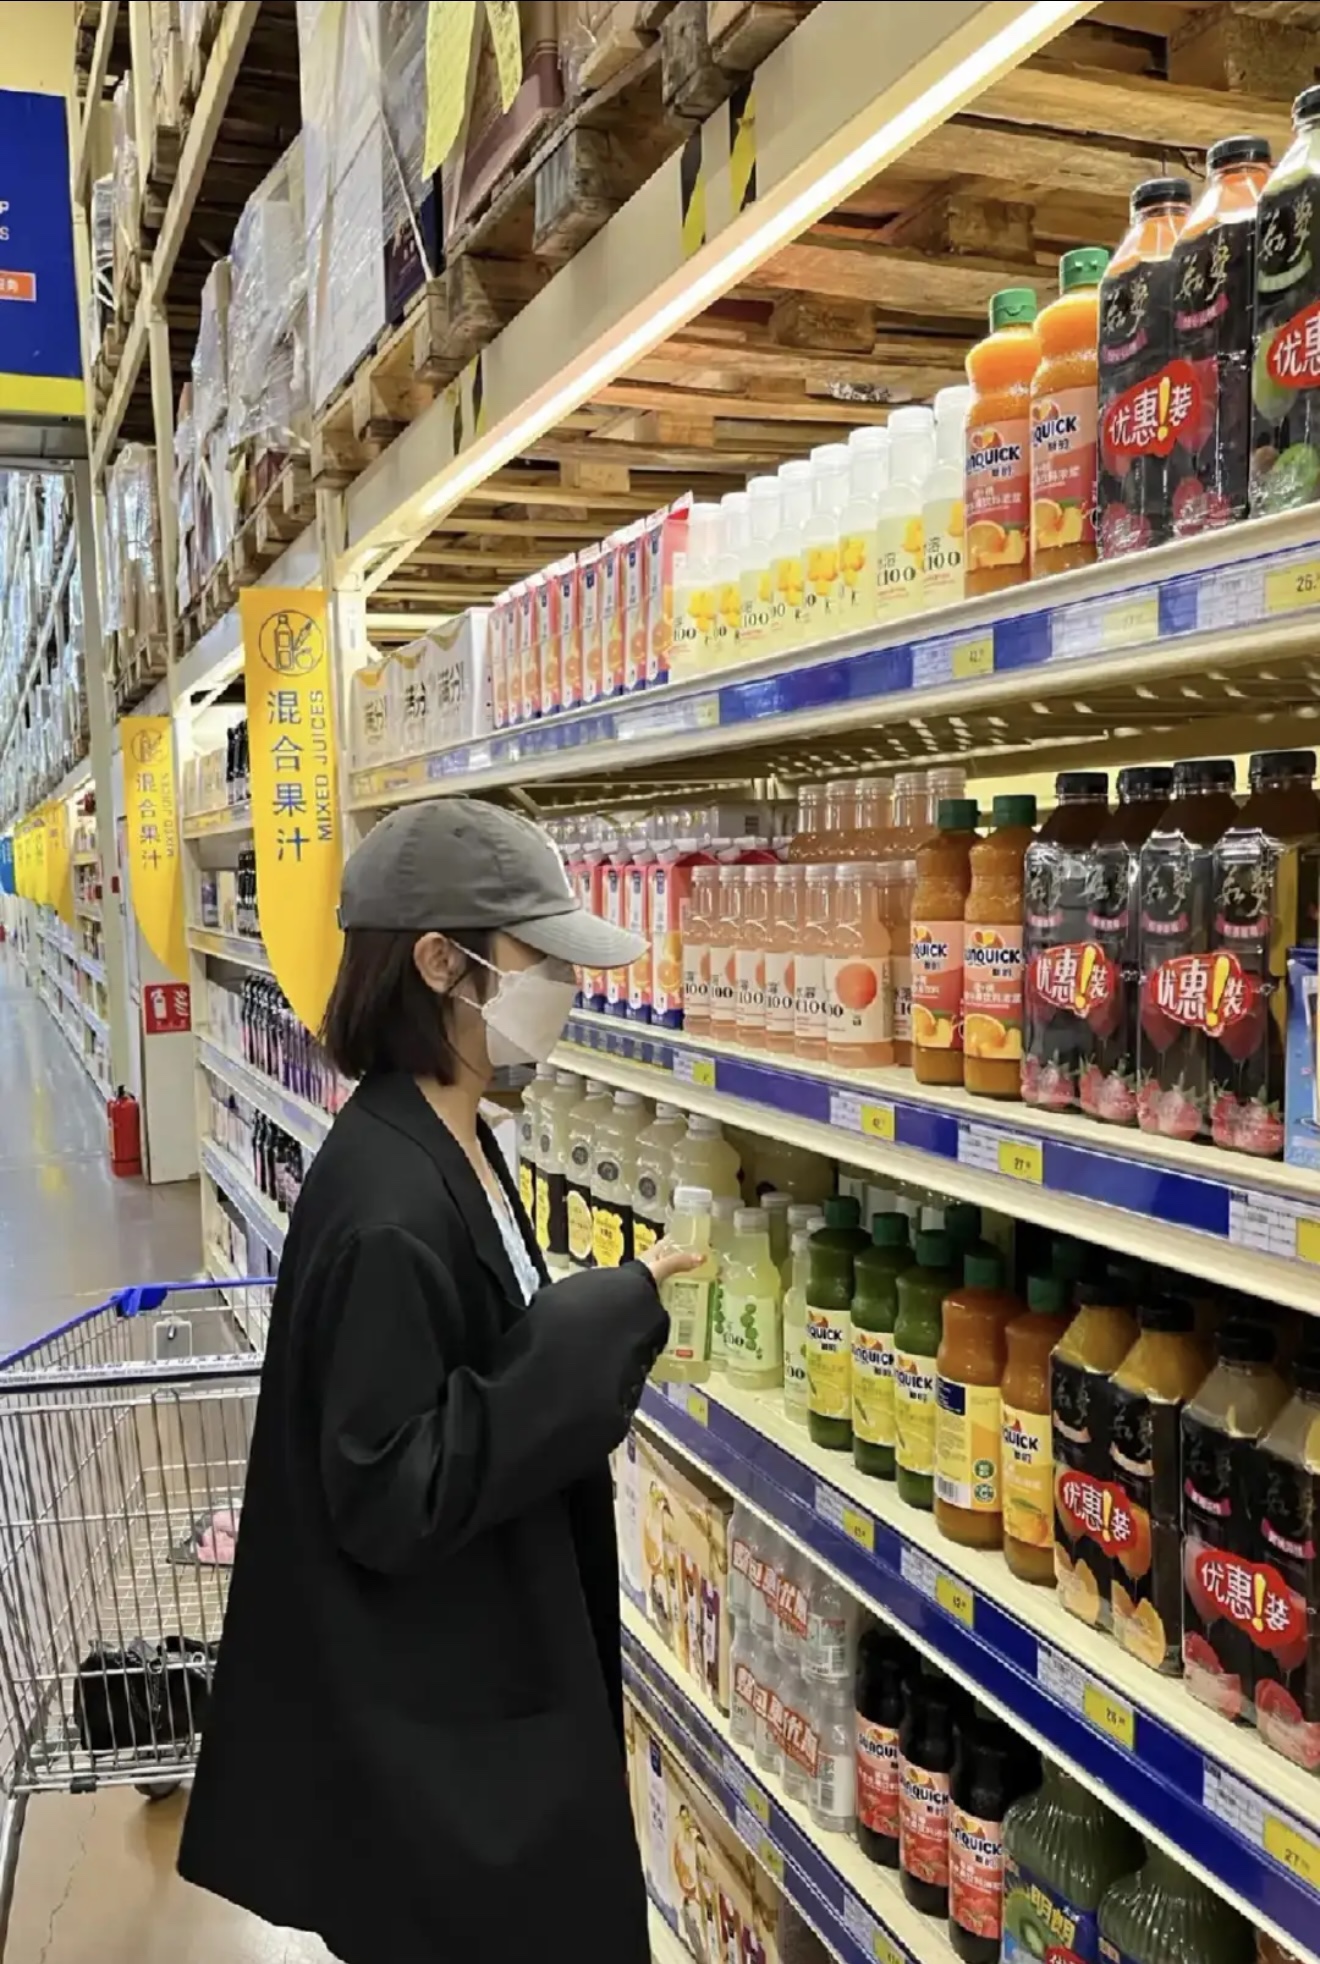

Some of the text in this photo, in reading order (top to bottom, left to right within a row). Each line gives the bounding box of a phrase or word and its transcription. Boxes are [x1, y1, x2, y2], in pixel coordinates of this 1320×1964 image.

[1109, 376, 1193, 446] 优惠!装
[267, 690, 310, 862] 混合果汁
[309, 690, 333, 841] MIXED JUICES
[136, 772, 162, 870] 混合果汁
[1036, 945, 1109, 1009] 优惠!装
[1157, 955, 1247, 1028] 优惠!装
[1062, 1481, 1131, 1542] 优惠!装
[1201, 1560, 1290, 1632] 优惠!装
